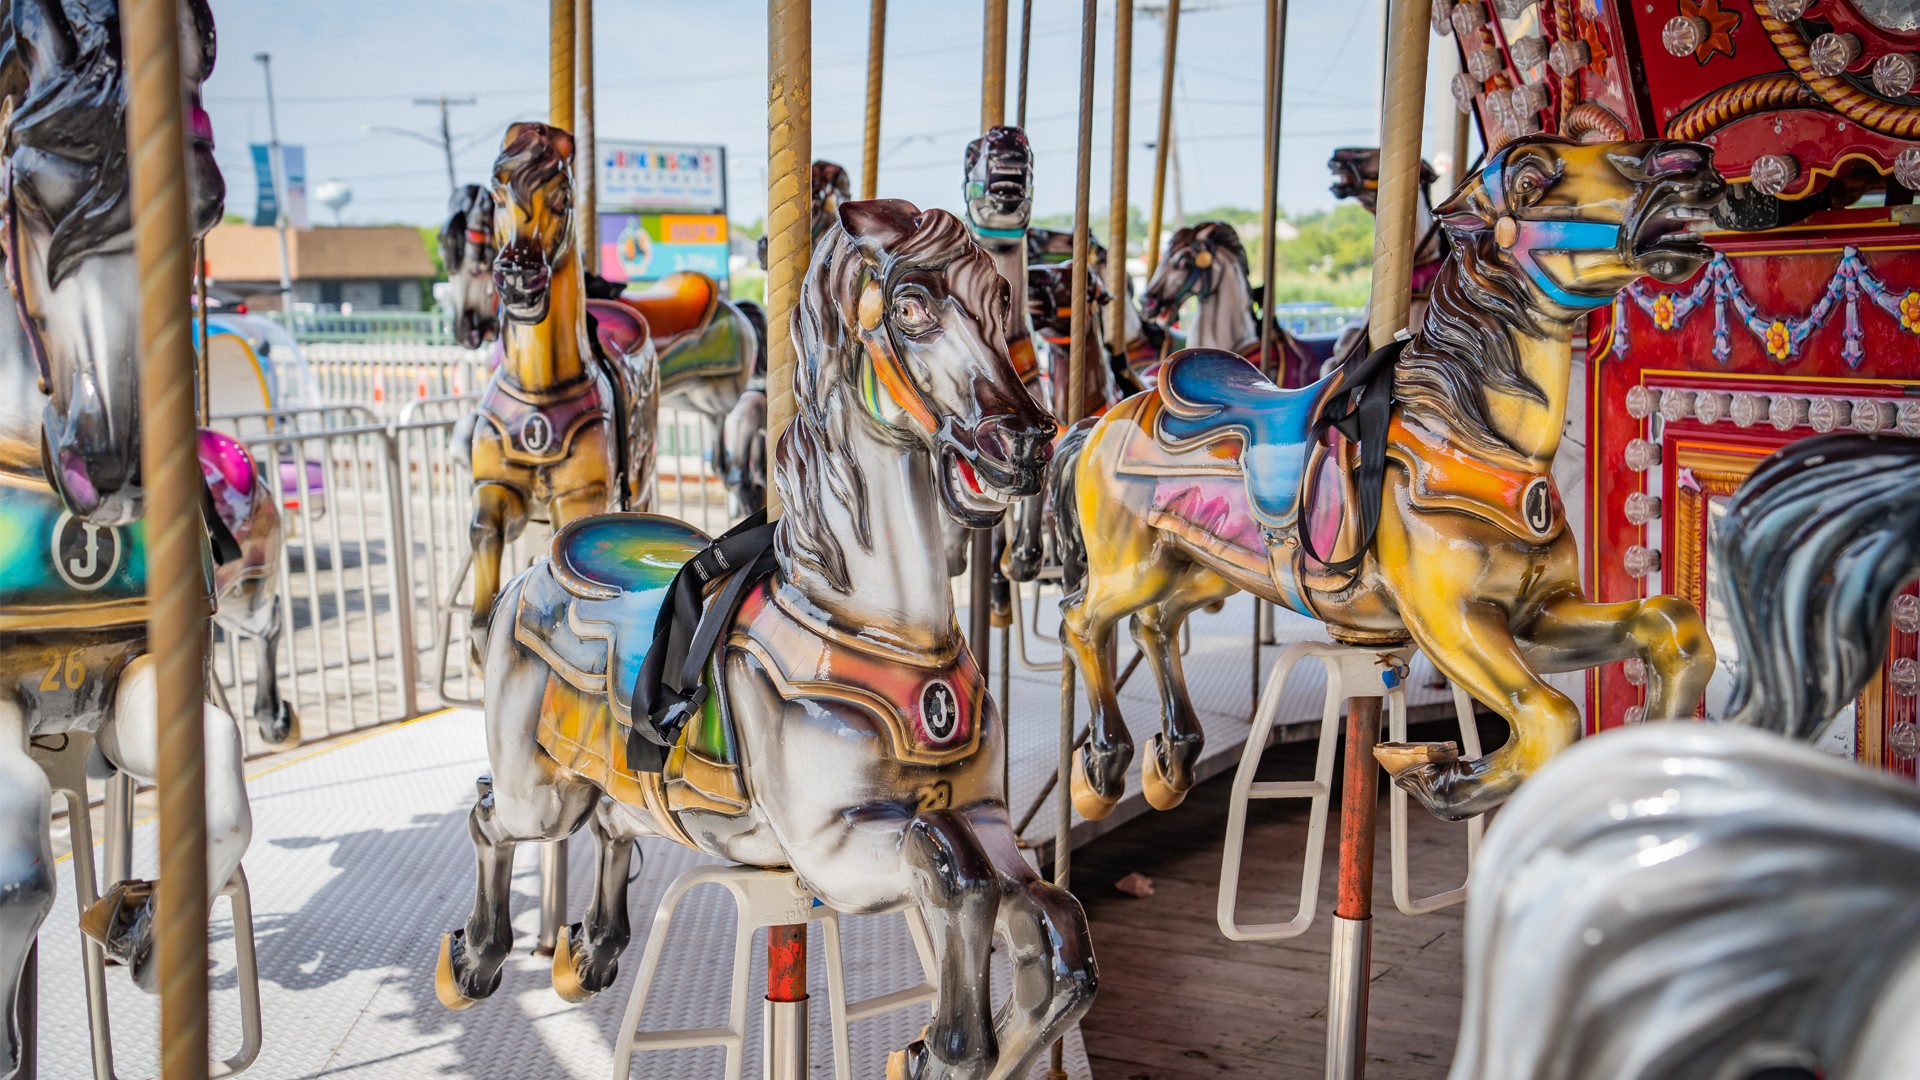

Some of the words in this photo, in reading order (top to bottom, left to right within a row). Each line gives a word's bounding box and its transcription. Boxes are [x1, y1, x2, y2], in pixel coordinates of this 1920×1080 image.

[528, 419, 543, 448] J
[1532, 487, 1547, 528] J
[69, 522, 100, 578] J
[1517, 563, 1546, 597] 17
[39, 646, 87, 692] 26
[932, 690, 948, 728] J
